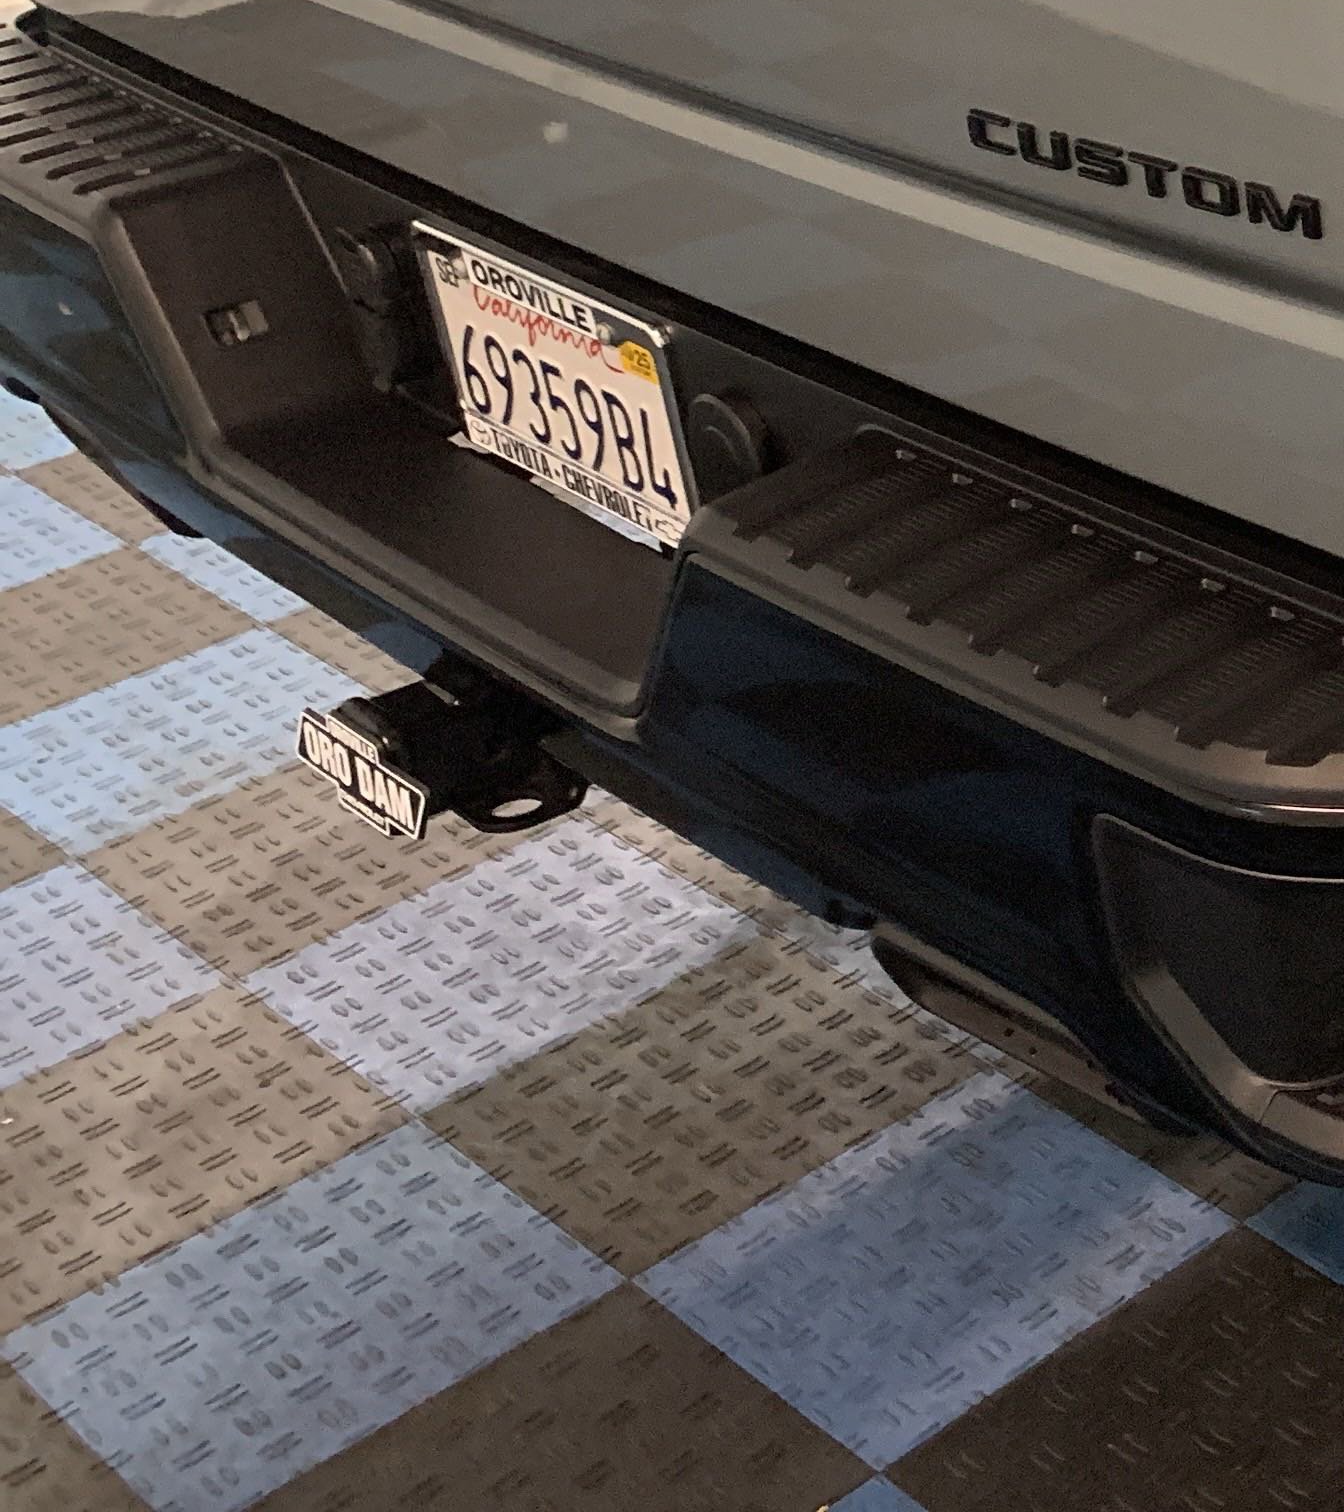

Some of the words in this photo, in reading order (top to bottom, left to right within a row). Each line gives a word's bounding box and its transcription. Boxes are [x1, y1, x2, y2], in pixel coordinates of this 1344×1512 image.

[967, 108, 1323, 240] CUSTOM
[471, 259, 592, 333] OROVILLE
[462, 324, 678, 510] 69359B4
[490, 428, 554, 480] TOYOTA
[561, 464, 655, 532] CHEVROLET
[303, 721, 353, 787] ORO
[354, 755, 415, 831] DAM
